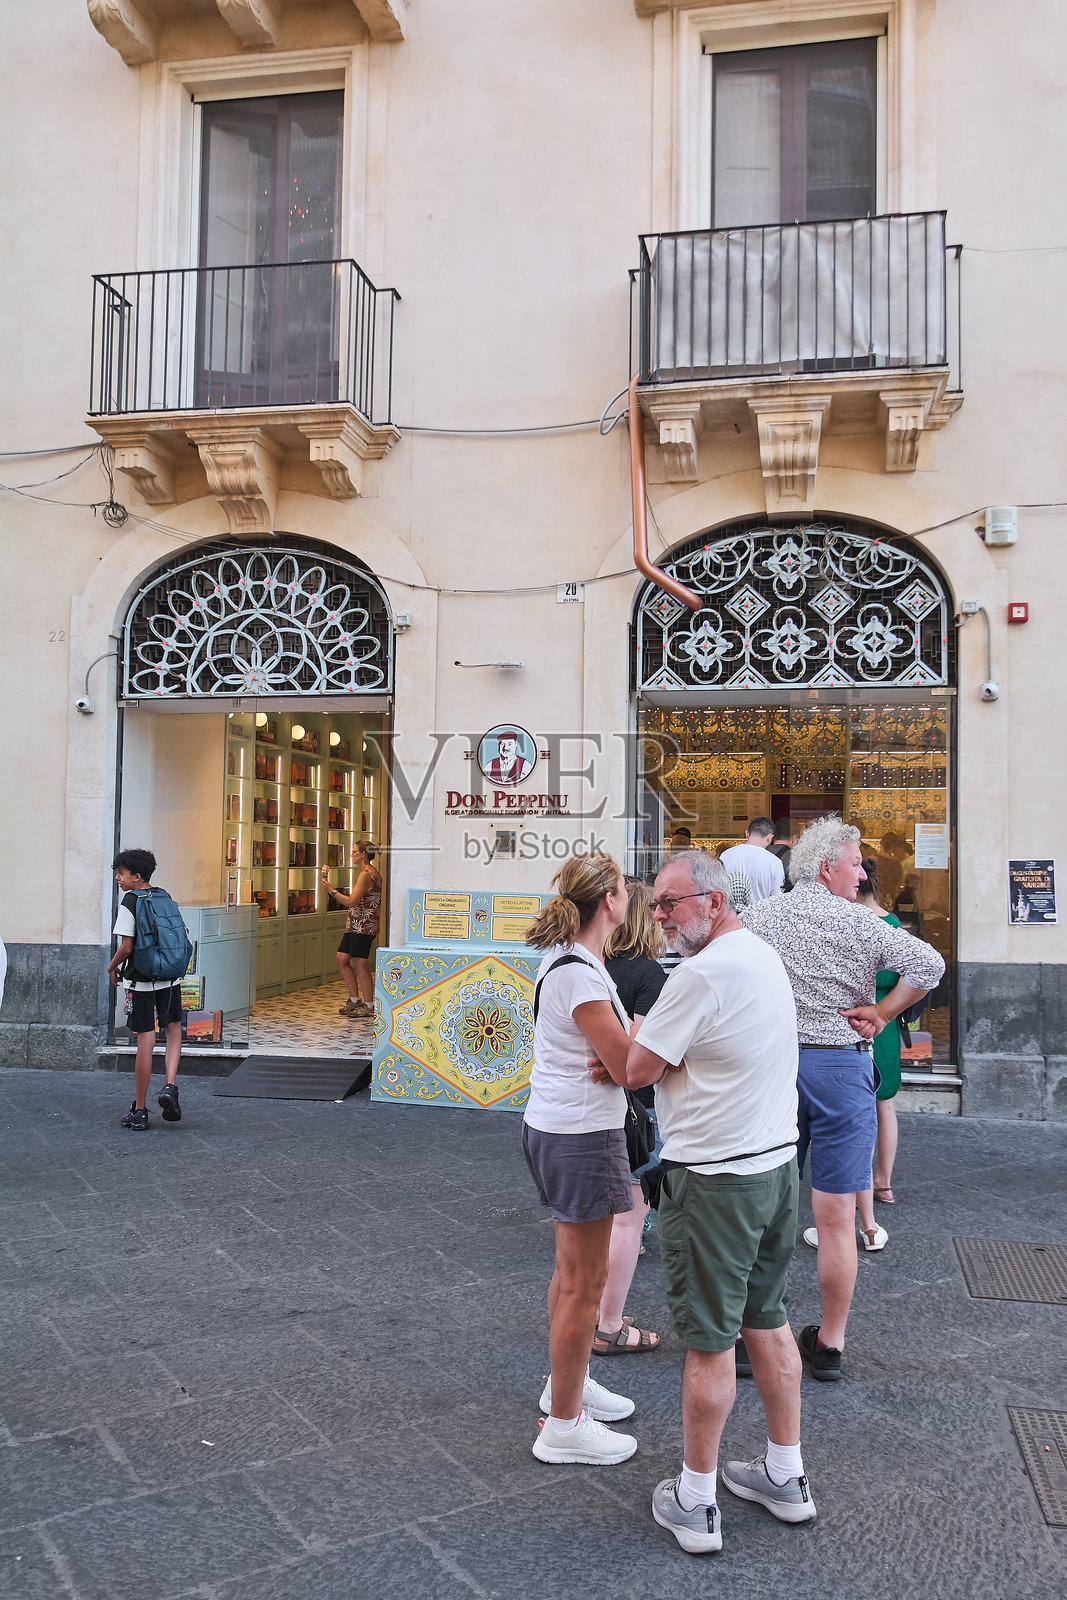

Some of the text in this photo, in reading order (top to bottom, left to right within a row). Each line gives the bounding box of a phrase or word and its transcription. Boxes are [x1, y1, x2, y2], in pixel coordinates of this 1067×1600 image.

[566, 582, 576, 595] 20
[48, 630, 66, 642] 22
[777, 763, 845, 790] DON
[446, 790, 568, 808] DON PEPPINU
